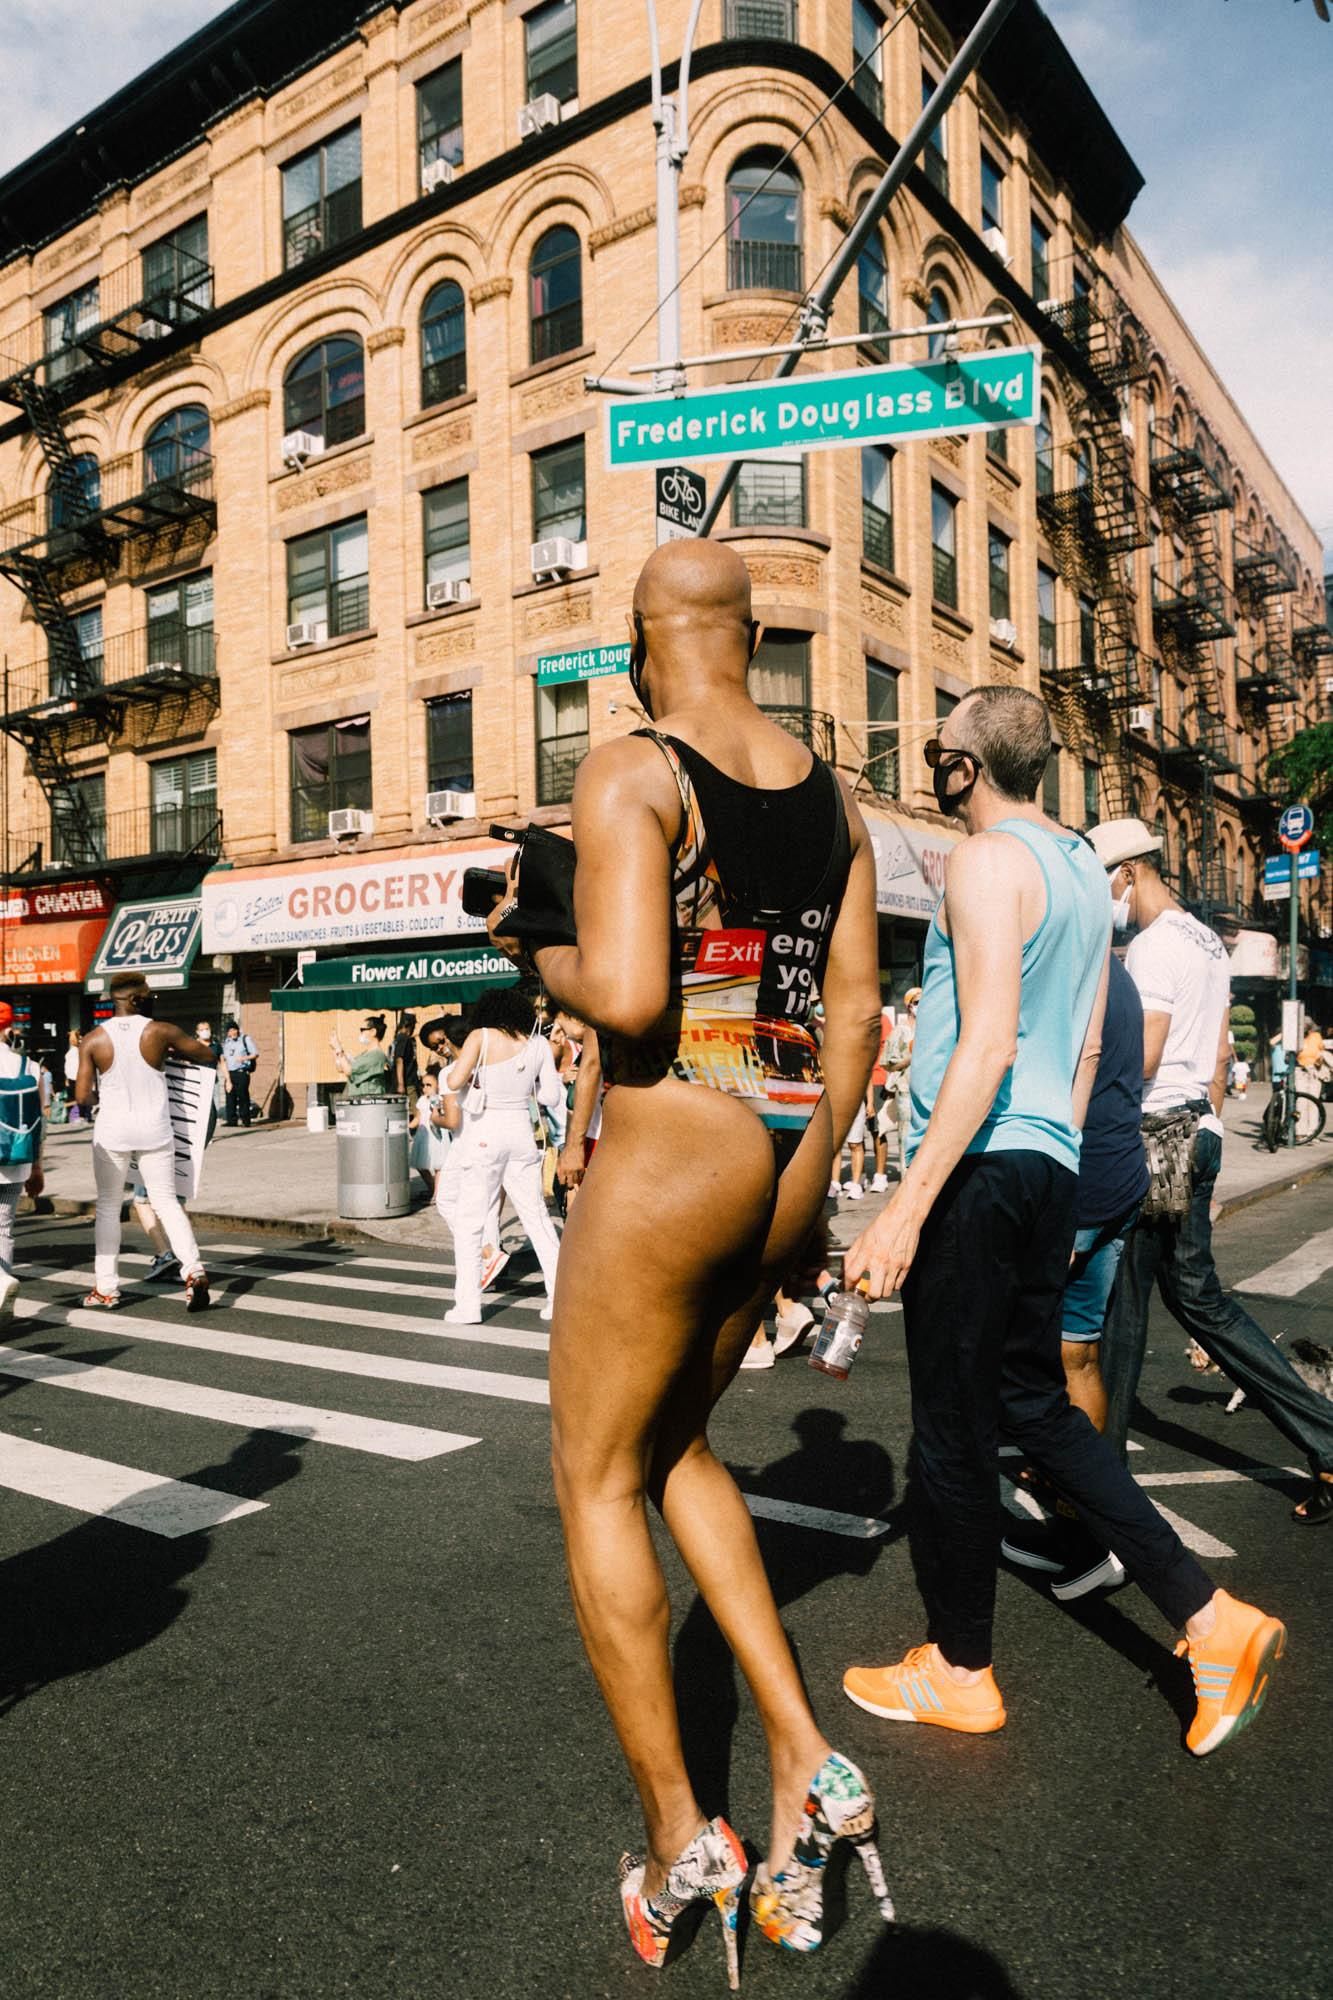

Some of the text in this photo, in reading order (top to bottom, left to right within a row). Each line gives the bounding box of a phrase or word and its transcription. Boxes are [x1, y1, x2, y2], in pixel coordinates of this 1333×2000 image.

[618, 372, 1023, 447] Frederick Douglass Blvd
[660, 501, 680, 521] BIKE
[541, 651, 596, 675] Frederick
[35, 890, 104, 914] CHICKEN
[288, 869, 457, 919] GROCERY
[286, 927, 326, 942] SANDWICHES
[330, 924, 353, 937] FRUITS
[355, 924, 359, 936] &
[361, 920, 404, 935] VEGETABLES
[409, 918, 428, 931] COLD
[430, 916, 445, 929] CUT
[704, 941, 762, 963] Exit
[352, 953, 519, 982] Flower All Occasions
